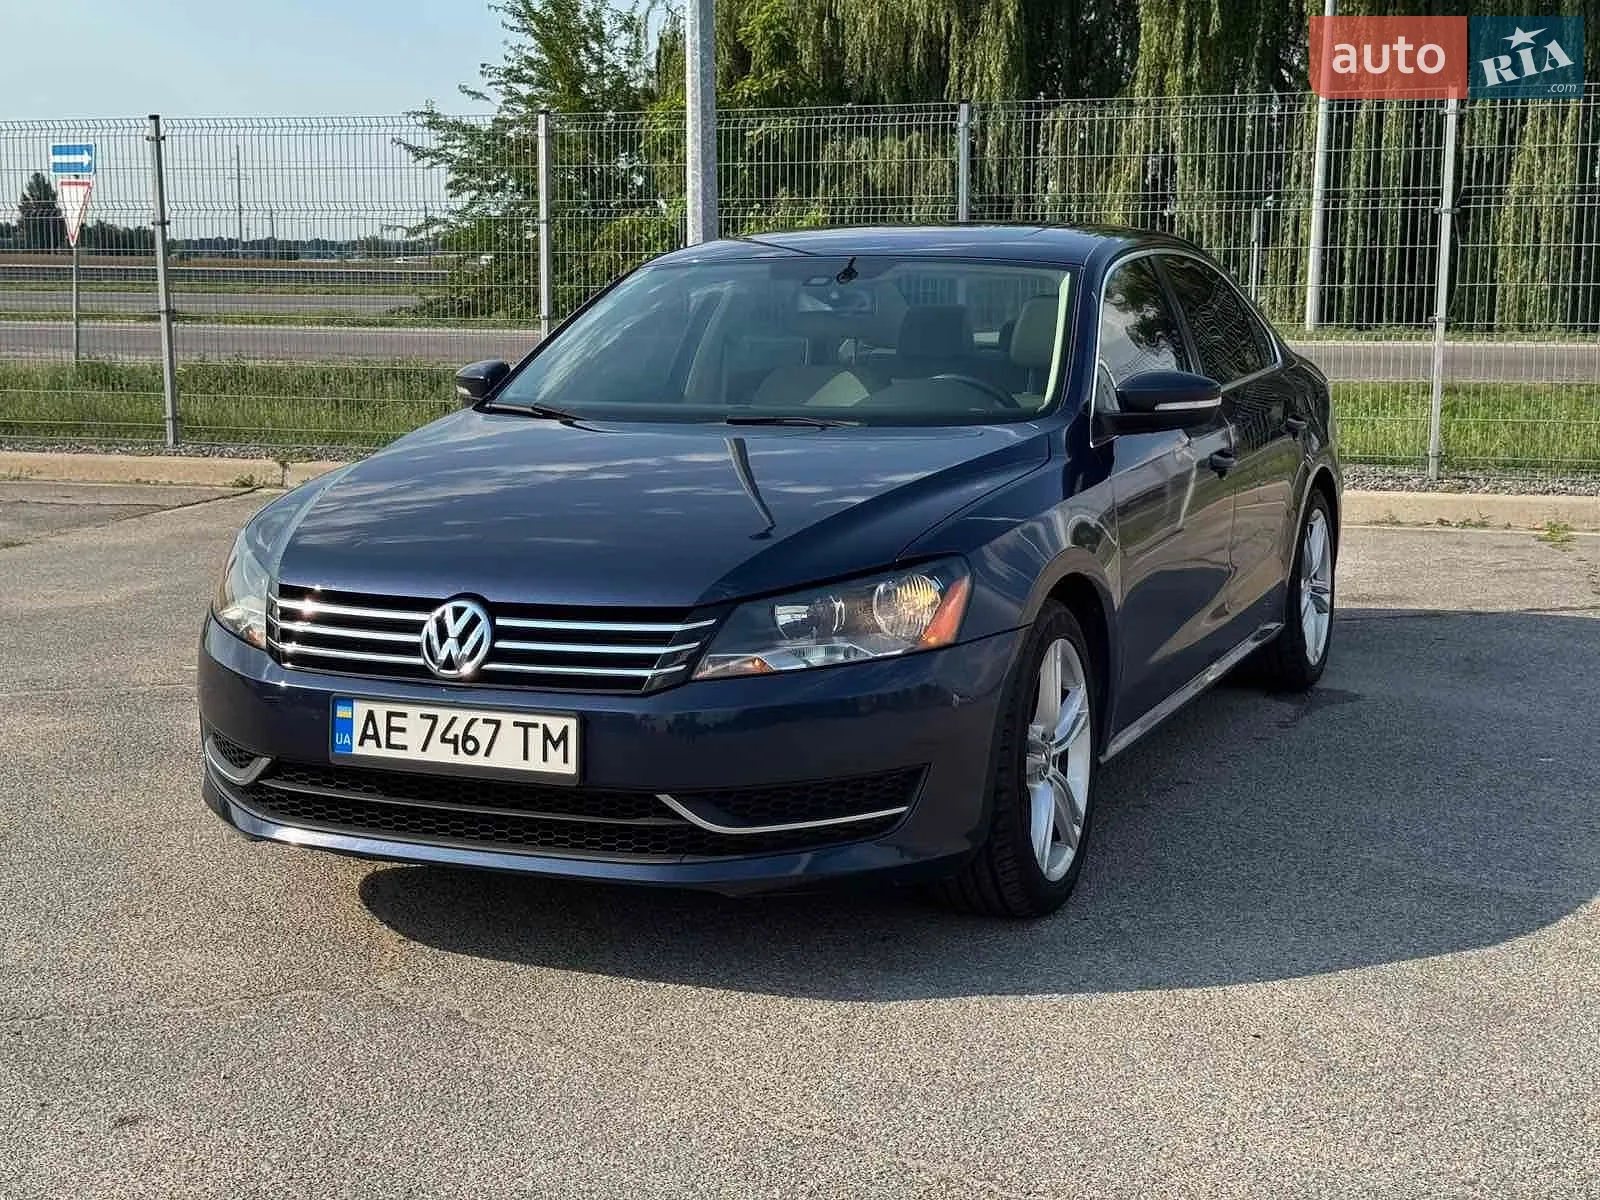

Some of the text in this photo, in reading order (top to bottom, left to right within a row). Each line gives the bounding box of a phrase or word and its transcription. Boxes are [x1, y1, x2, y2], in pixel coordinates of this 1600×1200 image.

[335, 732, 351, 745] UA
[357, 709, 569, 765] AE 7467 TM
